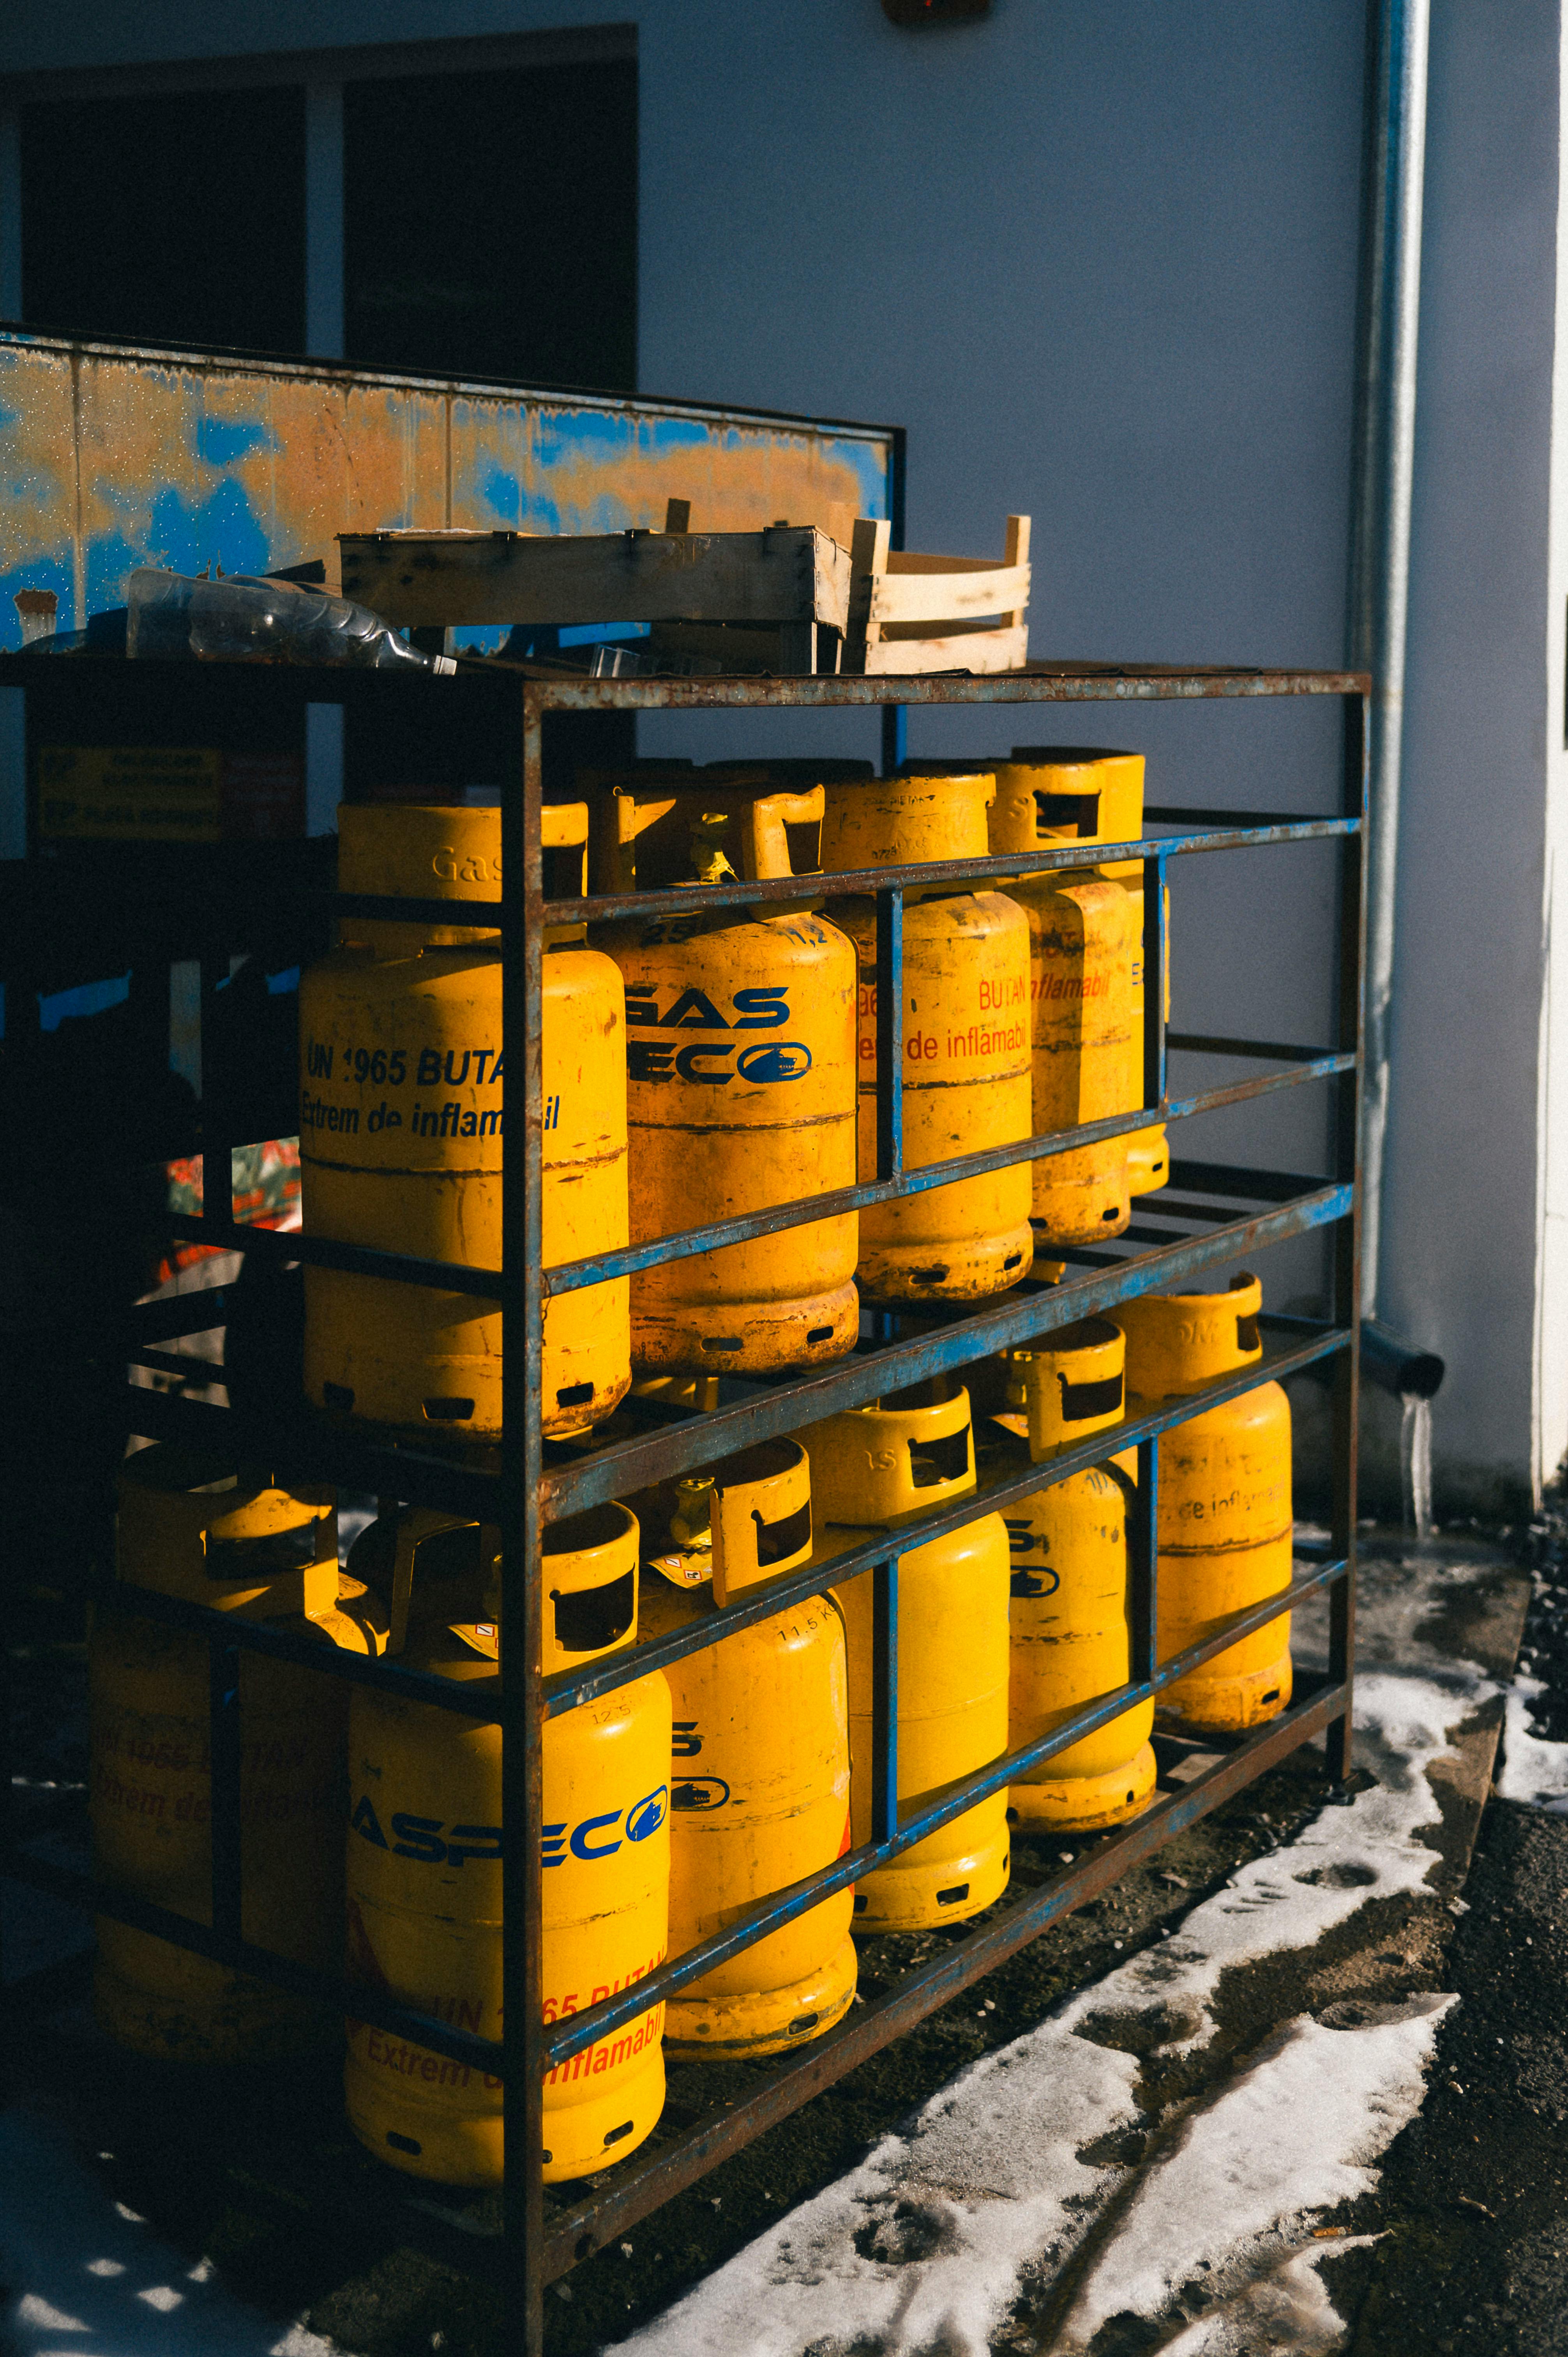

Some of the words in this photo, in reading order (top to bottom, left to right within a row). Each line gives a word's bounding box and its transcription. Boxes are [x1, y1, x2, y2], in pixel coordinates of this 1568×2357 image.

[1031, 969, 1111, 1001] nflamabil
[907, 1031, 938, 1060] de
[947, 1018, 1026, 1058] inflamabil
[308, 1038, 333, 1079] UN
[343, 1047, 406, 1085] 1965
[417, 1048, 503, 1087] BUTA
[627, 1041, 812, 1085] ECO
[367, 1101, 402, 1134] de
[412, 1095, 560, 1137] inflamil
[777, 1618, 818, 1641] 11.5
[351, 1785, 668, 1868] ASPECO
